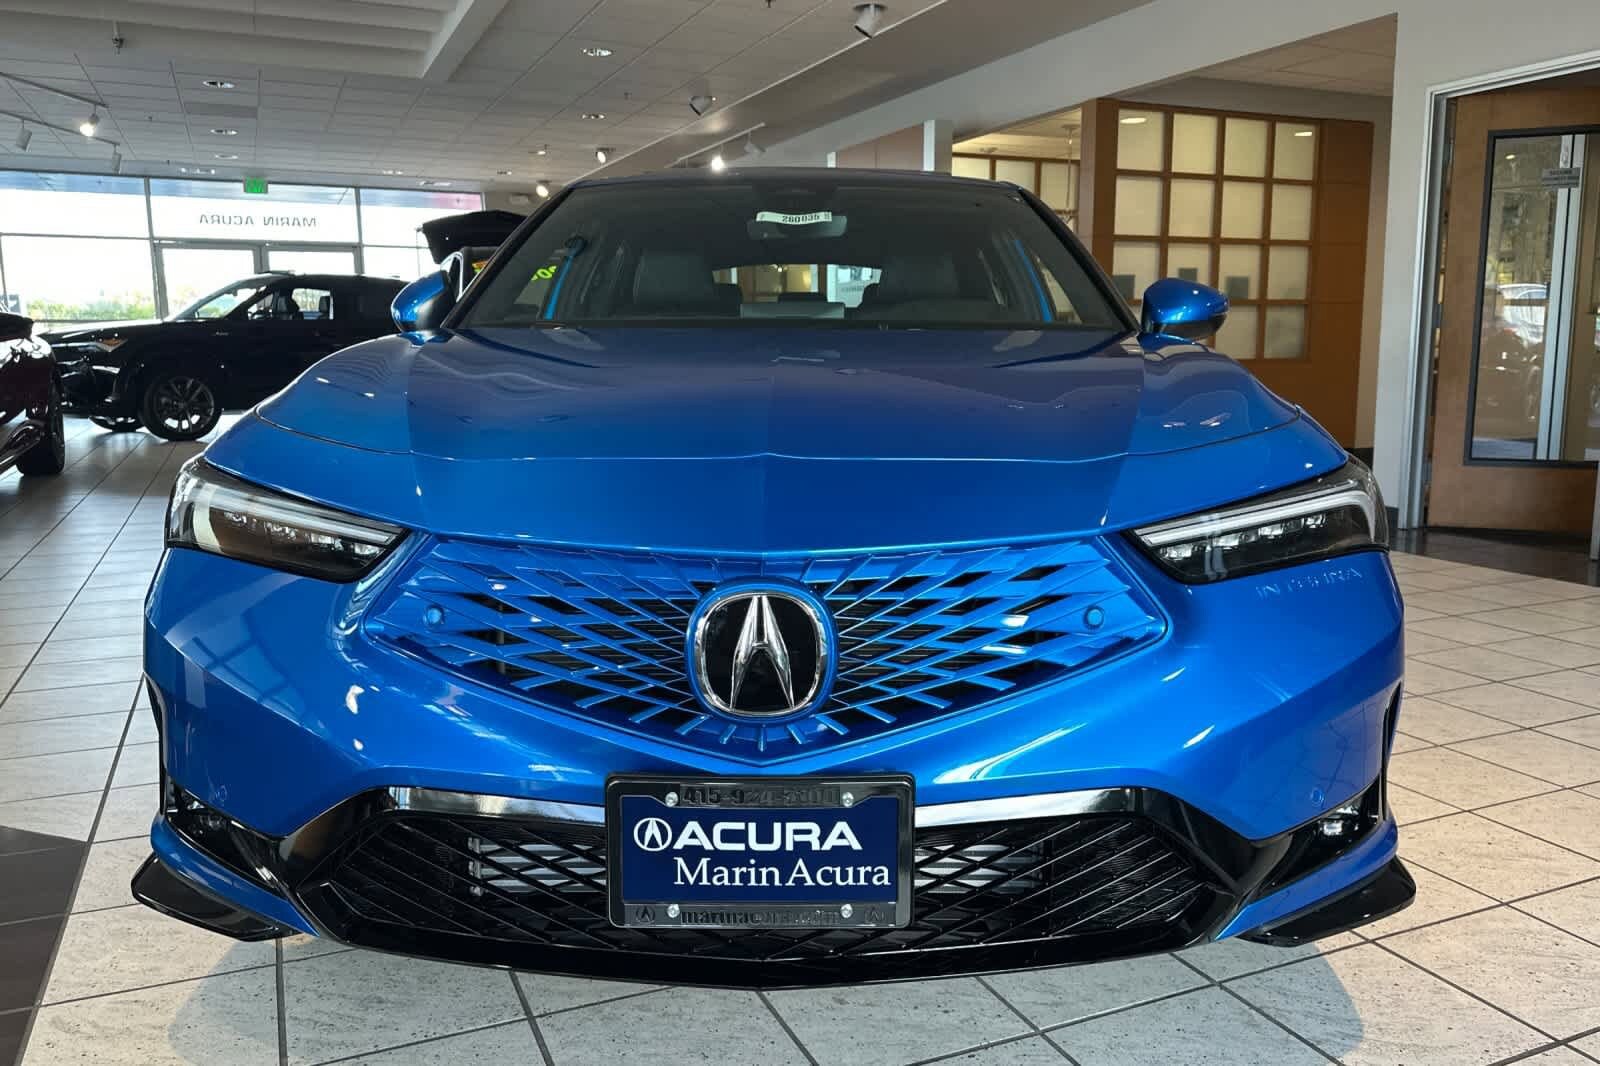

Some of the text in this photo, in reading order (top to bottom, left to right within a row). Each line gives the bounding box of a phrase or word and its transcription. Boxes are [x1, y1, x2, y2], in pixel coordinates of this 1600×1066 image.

[672, 821, 863, 851] ACURA
[673, 857, 892, 886] Marin Acura
